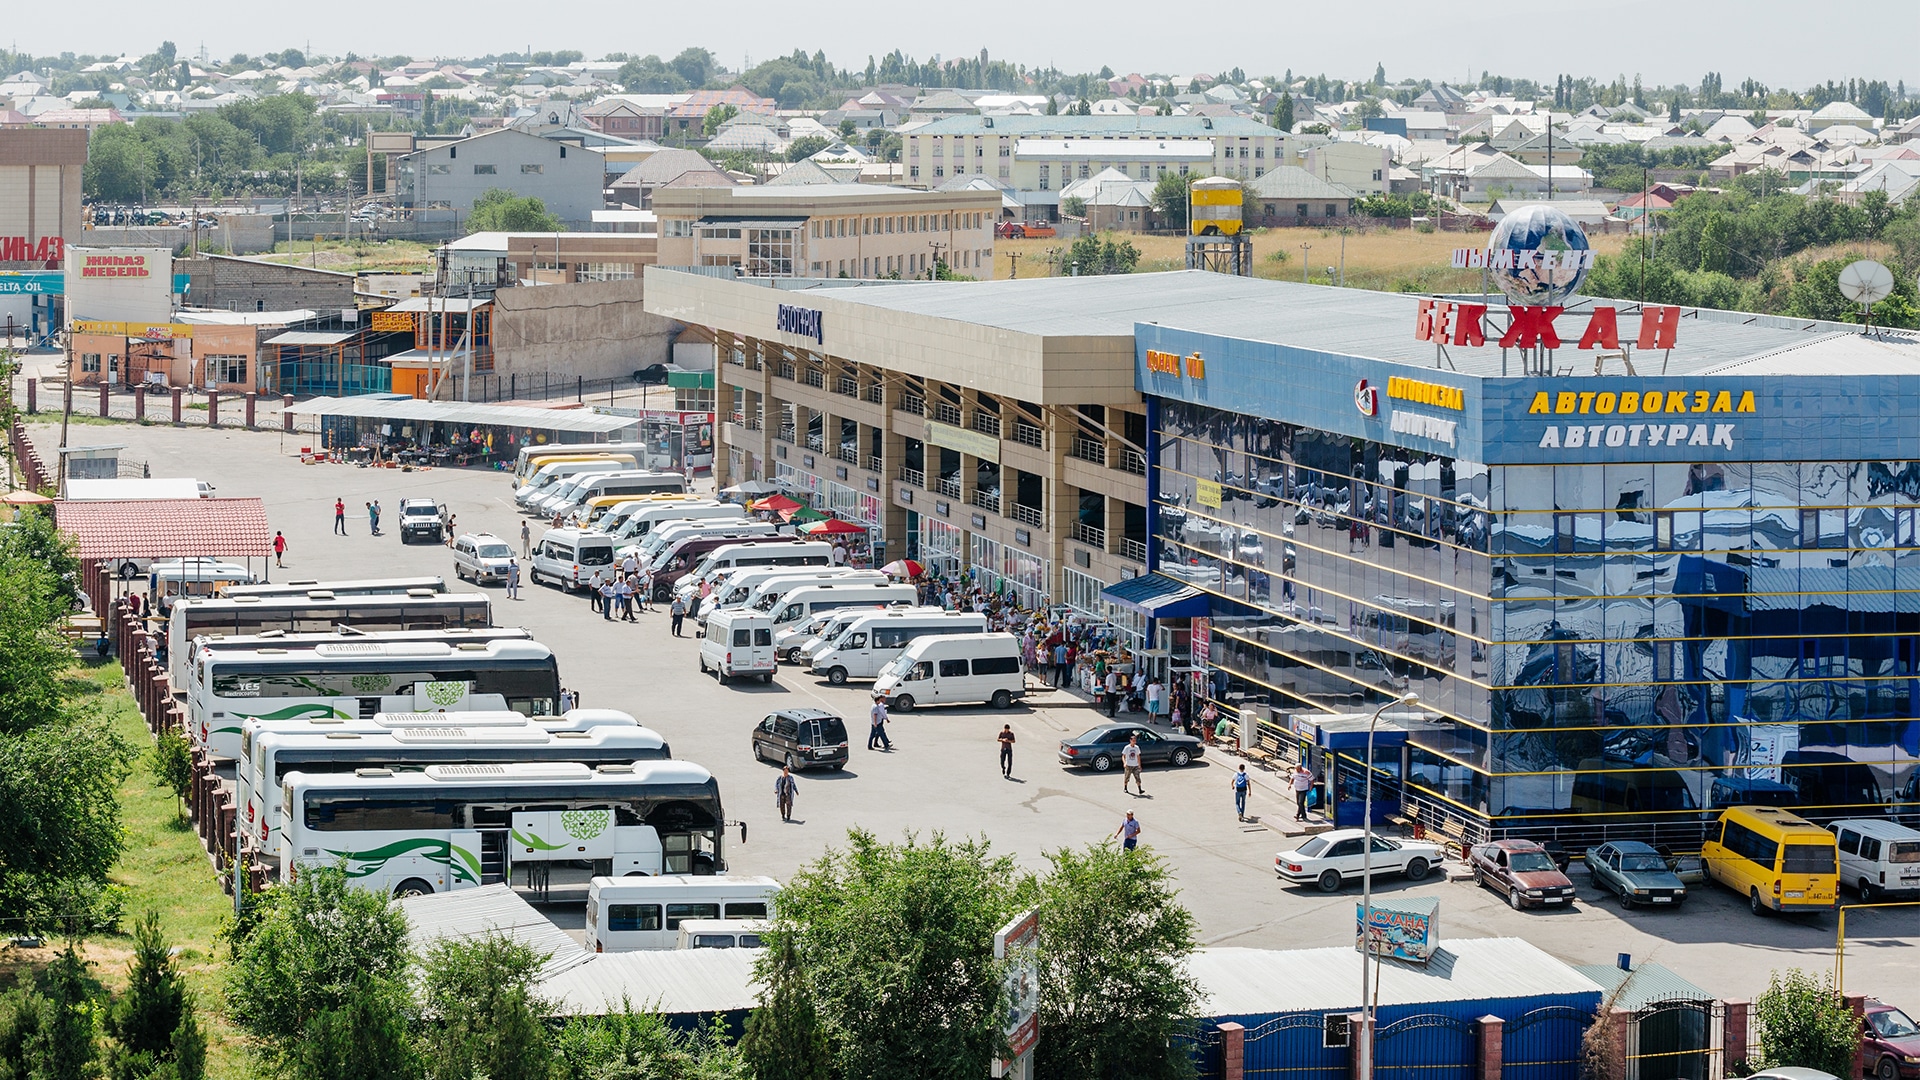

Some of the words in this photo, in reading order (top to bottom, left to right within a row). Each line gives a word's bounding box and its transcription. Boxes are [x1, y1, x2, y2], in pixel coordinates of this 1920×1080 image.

[0, 236, 65, 262] ИҺАЗ
[1451, 249, 1598, 270] ШЫМКЕНТ
[82, 267, 149, 277] МЕБЕЛЬ
[86, 256, 145, 266] ЖИҺАЗ
[25, 282, 43, 292] OIL
[372, 313, 411, 322] БЕРЕКЕ
[1415, 300, 1681, 350] БЕКЖАН
[1386, 375, 1465, 411] АВТОВОКЗАЛ
[1528, 391, 1756, 415] АВТОВОКЗАЛ
[1538, 423, 1736, 451] АВТОТҰРАҚ
